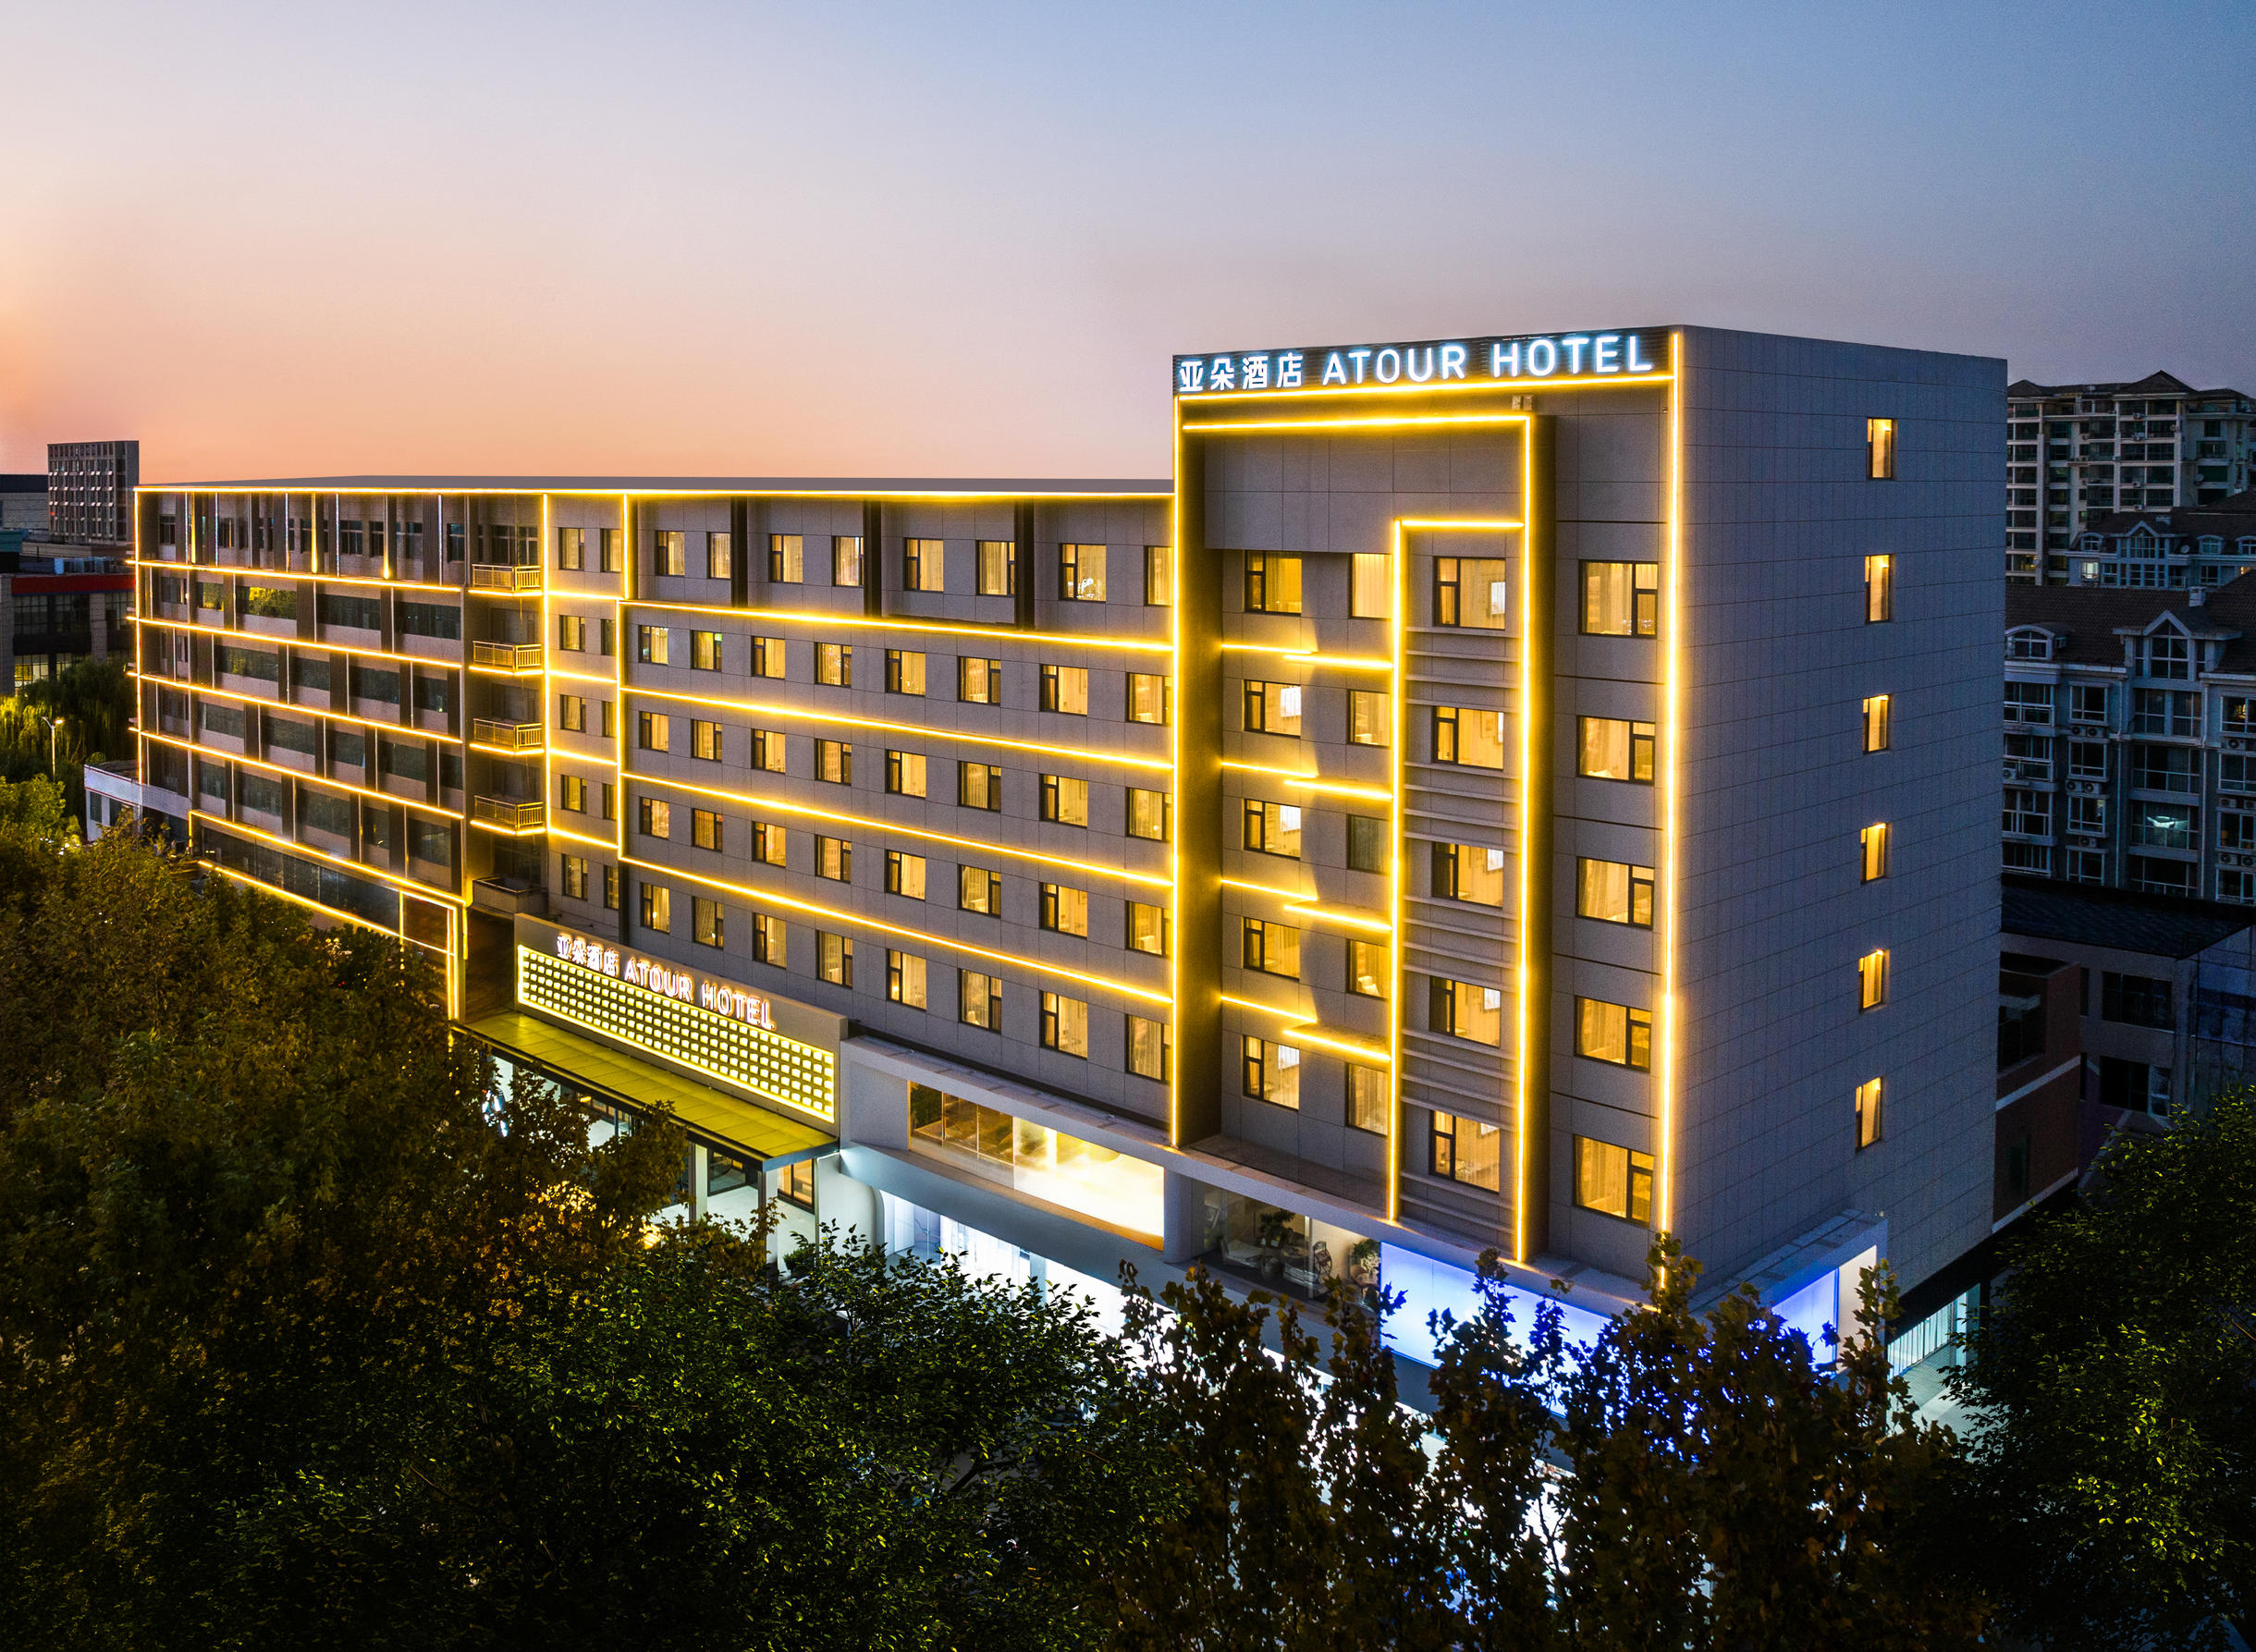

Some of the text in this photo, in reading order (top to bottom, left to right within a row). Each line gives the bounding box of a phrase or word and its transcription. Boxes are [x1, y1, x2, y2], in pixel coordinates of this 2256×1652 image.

[1179, 335, 1653, 392] 亚朵酒店 ATOUR HOTEL
[557, 934, 777, 1031] 亚朵酒店 ATOUR HOTEL
